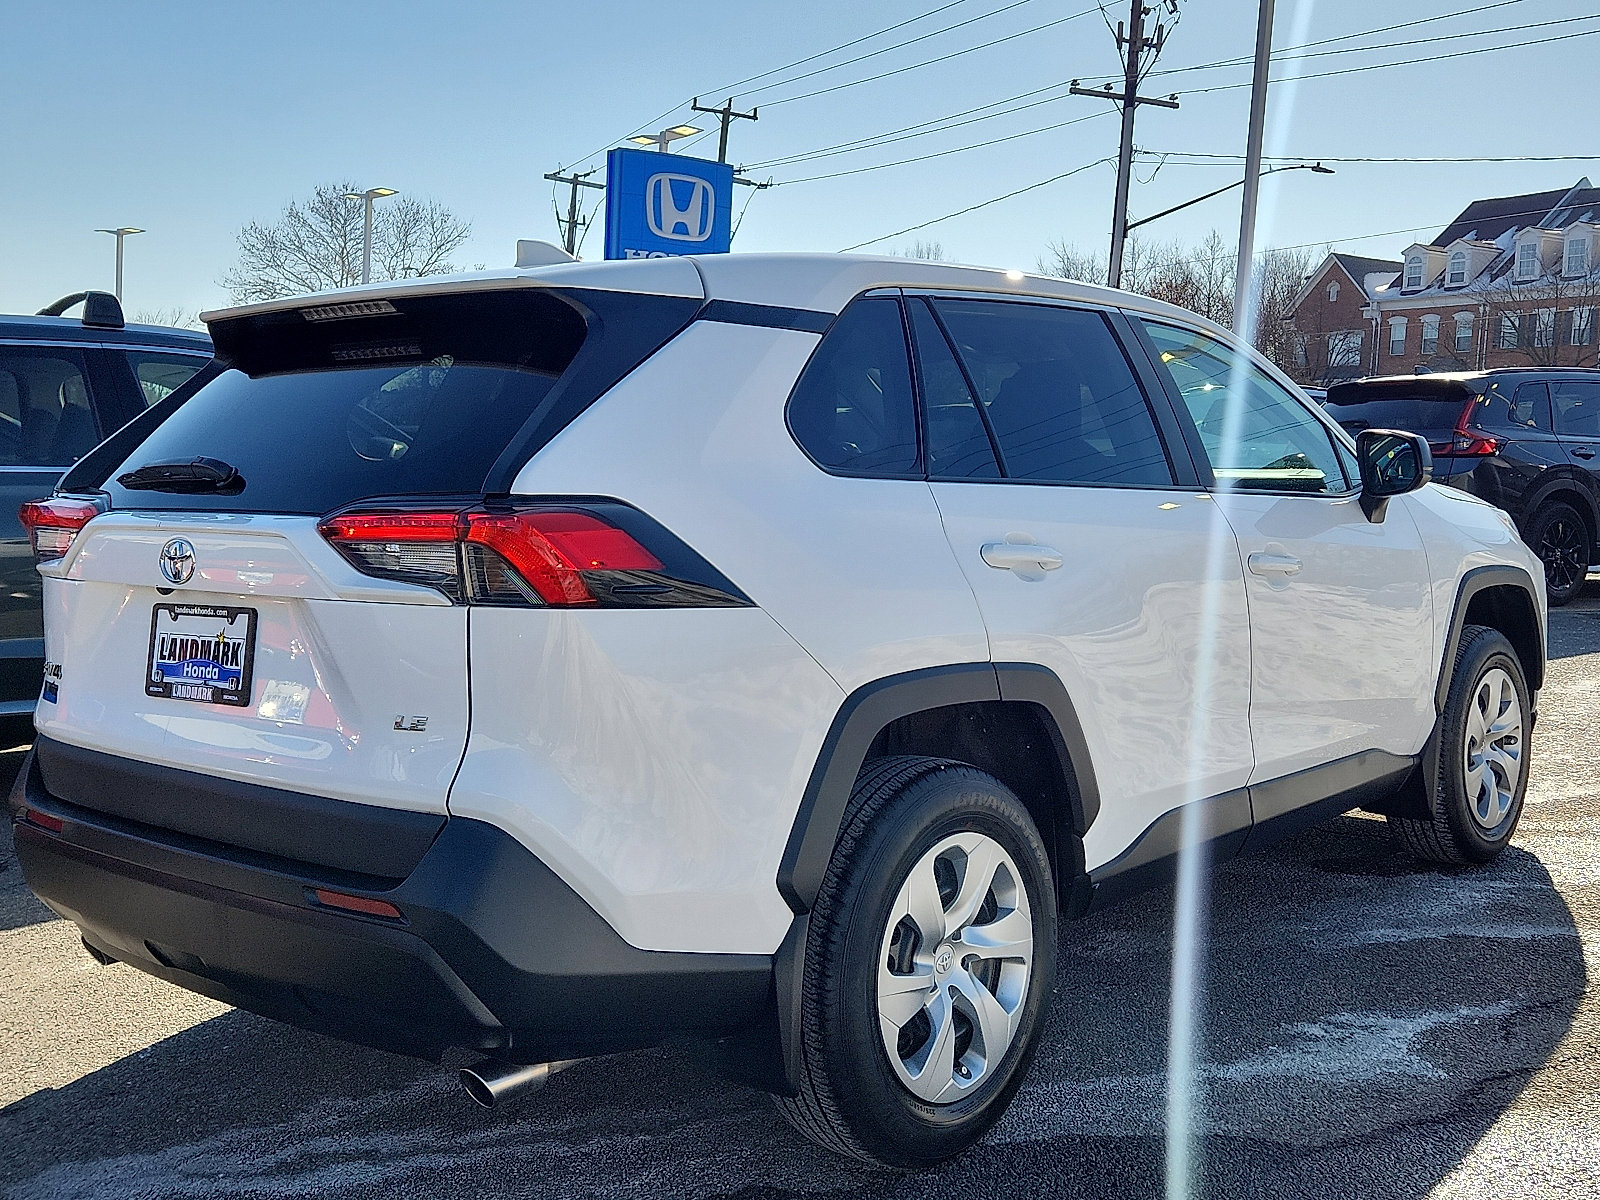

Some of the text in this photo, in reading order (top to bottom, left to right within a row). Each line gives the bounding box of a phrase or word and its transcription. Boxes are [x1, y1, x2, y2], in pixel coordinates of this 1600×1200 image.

[159, 636, 241, 667] LANDMARK
[183, 662, 219, 679] Honda
[172, 684, 213, 700] LANDMARK
[393, 715, 429, 731] LE
